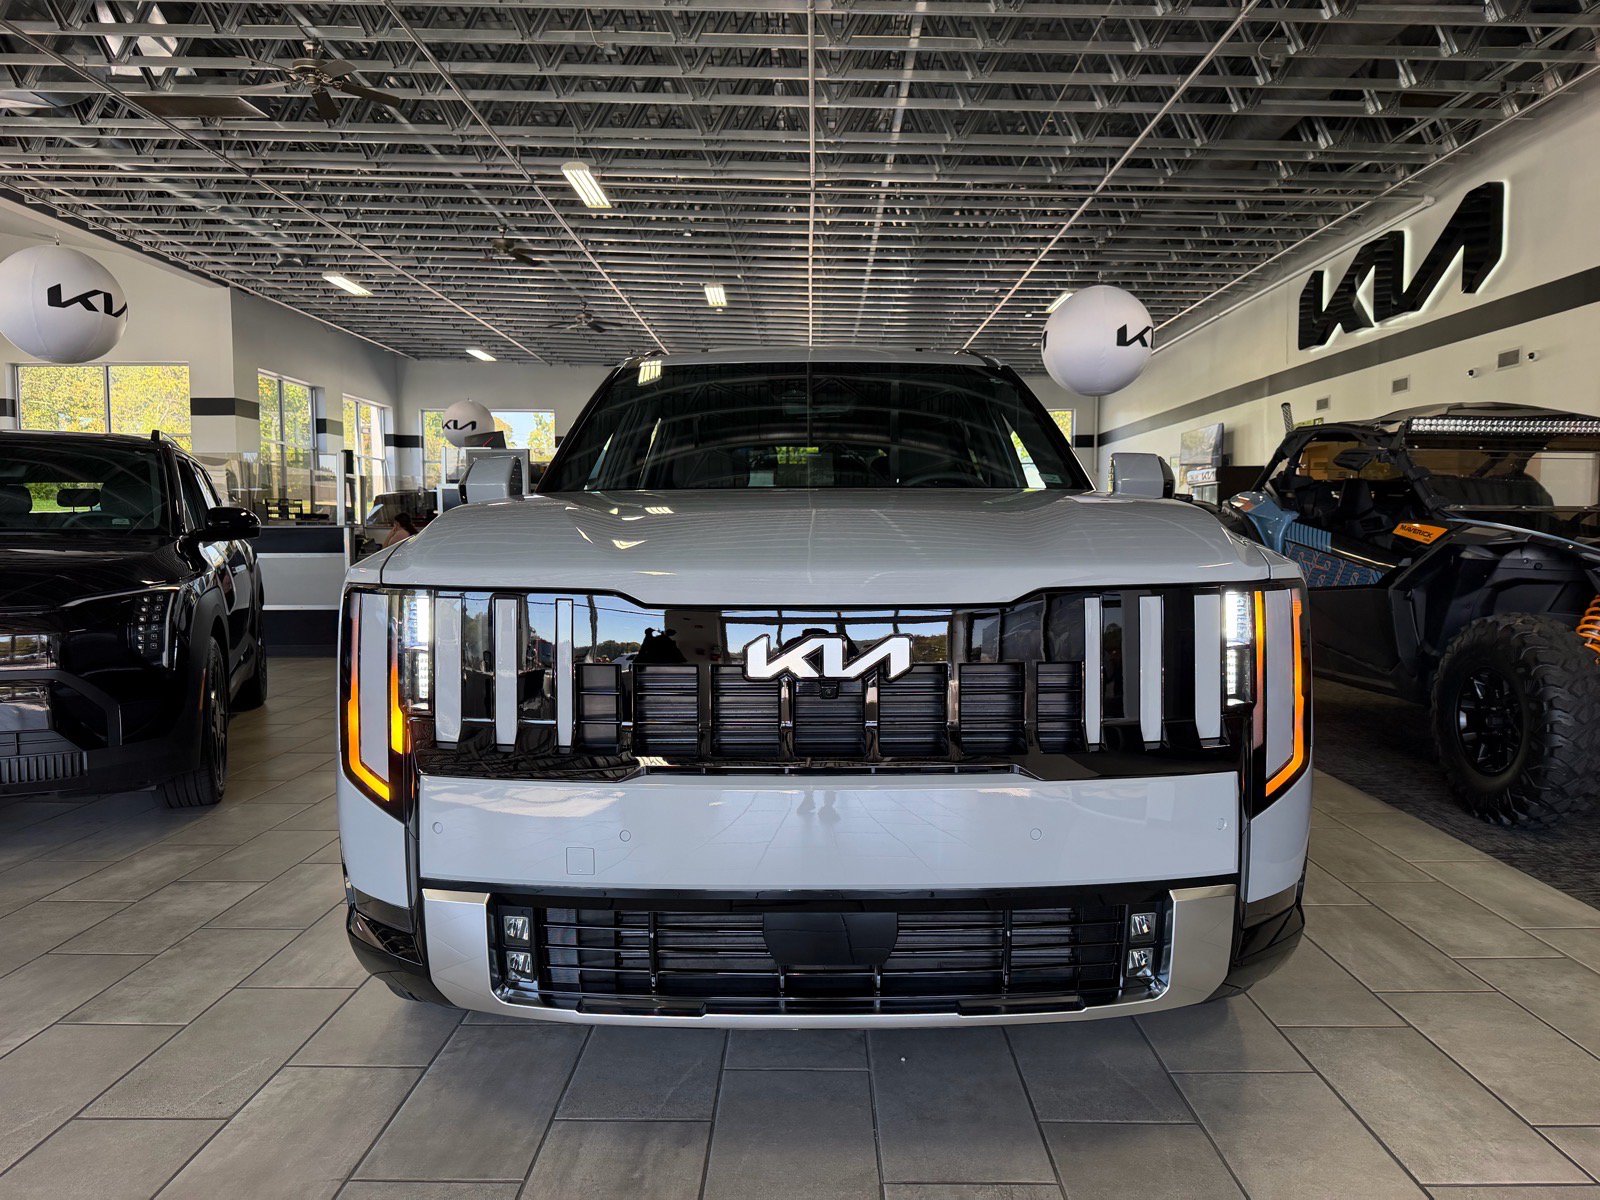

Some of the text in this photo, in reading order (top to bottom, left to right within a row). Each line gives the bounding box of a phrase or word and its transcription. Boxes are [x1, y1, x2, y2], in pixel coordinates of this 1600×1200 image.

[1298, 182, 1504, 350] KIA
[1401, 525, 1432, 538] MAVERICK
[745, 635, 912, 681] KIA
